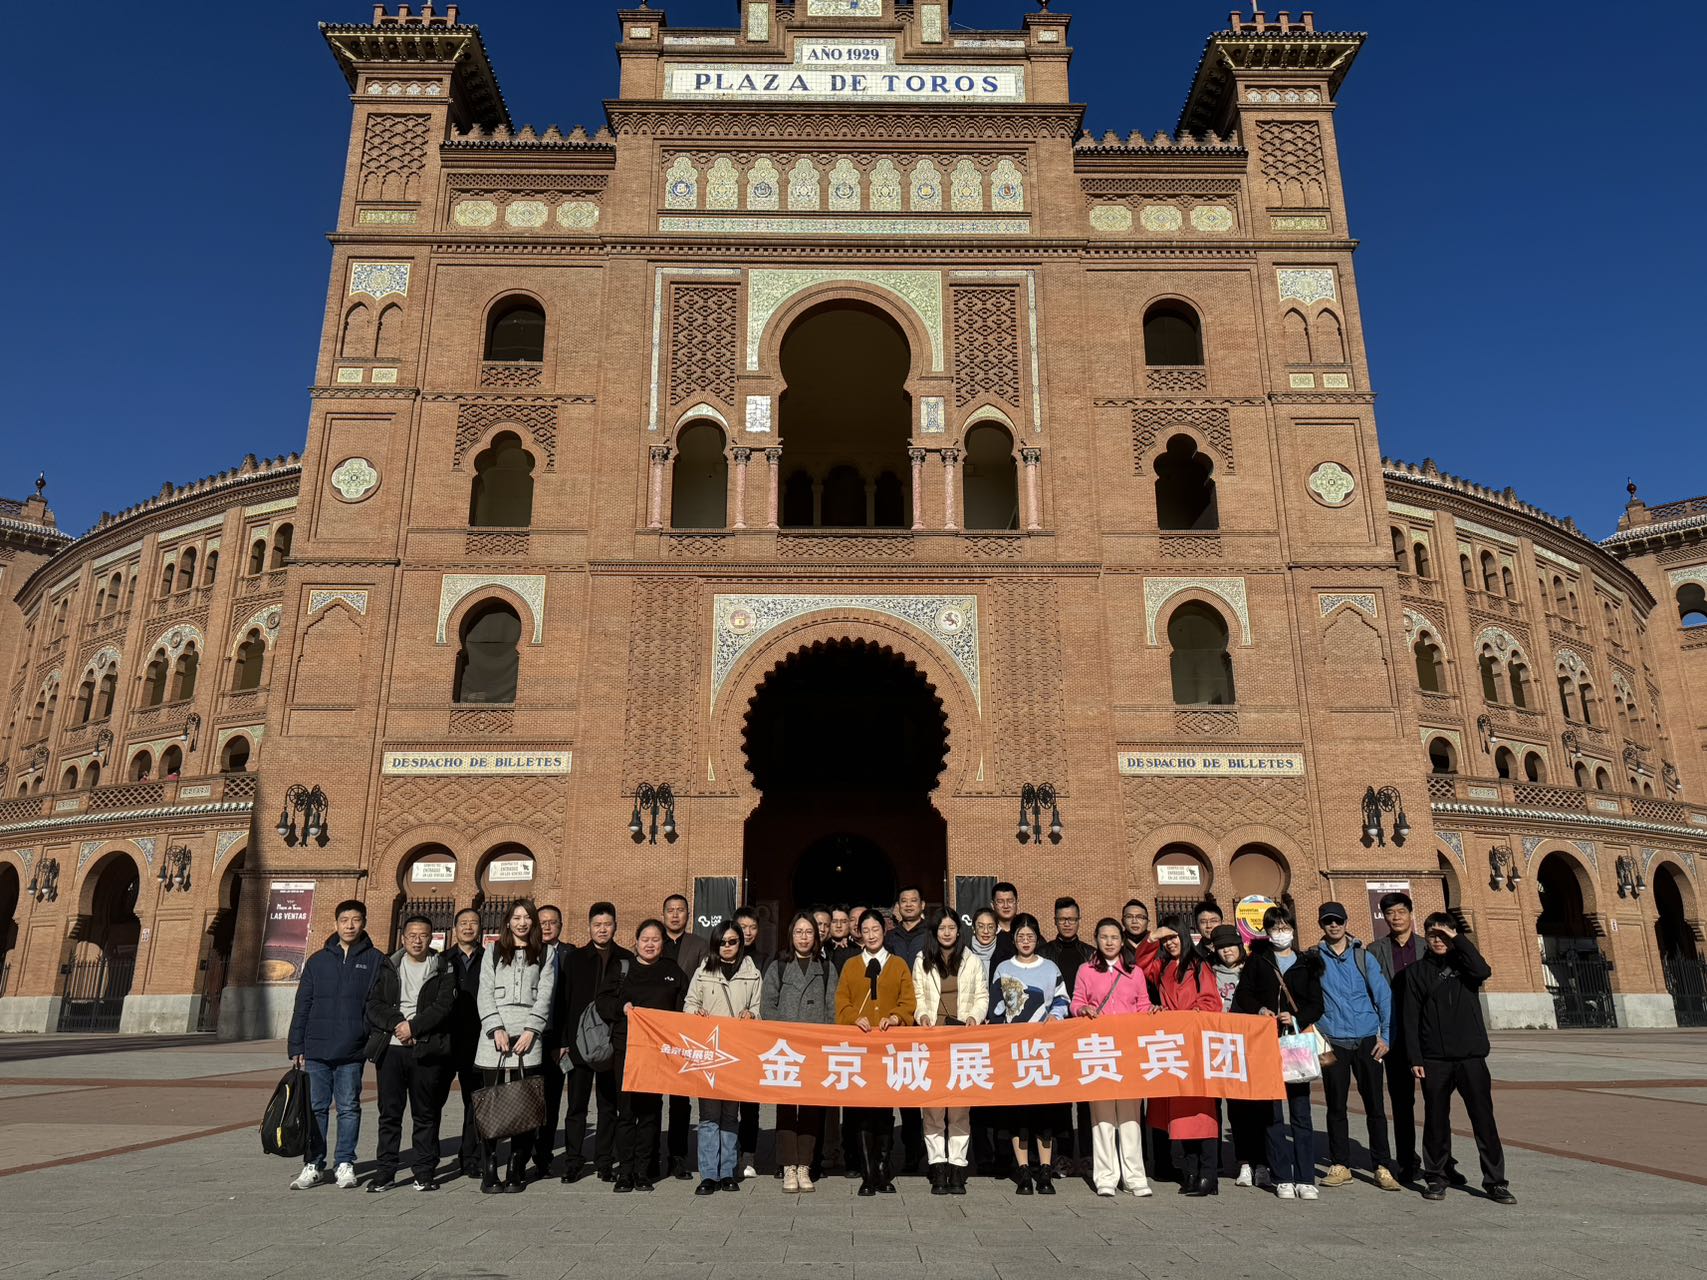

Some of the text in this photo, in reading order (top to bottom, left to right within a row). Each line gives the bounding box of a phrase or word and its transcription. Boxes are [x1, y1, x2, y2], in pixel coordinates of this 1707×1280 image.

[808, 46, 879, 60] AÑO 1929
[694, 73, 998, 92] PLAZA DE TOROS
[392, 757, 562, 768] DESPACHO DE BILLETES
[1126, 758, 1294, 768] DESPACHO DE BILLETES
[270, 912, 308, 920] LAS VENTAS
[1373, 912, 1385, 920] LA
[758, 1029, 1248, 1091] 金京诚展览贵宾团
